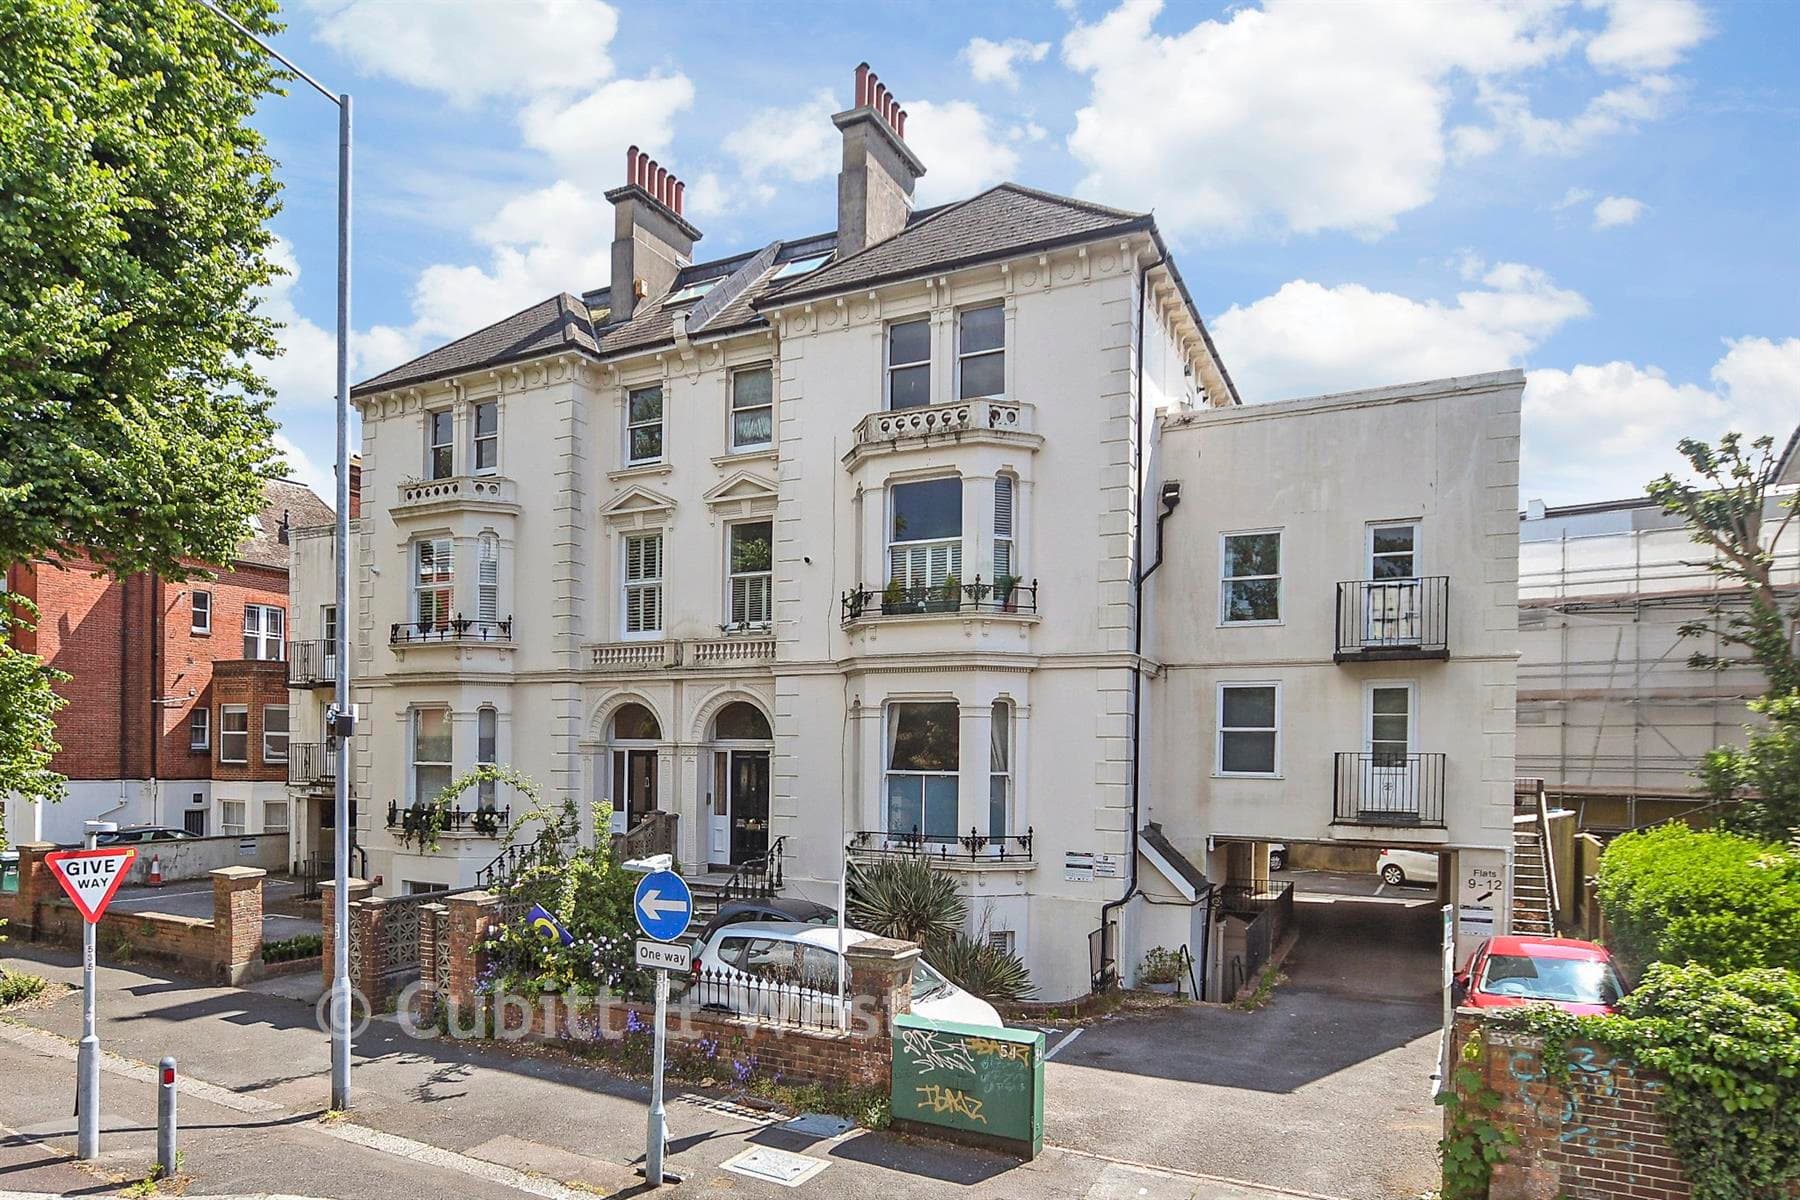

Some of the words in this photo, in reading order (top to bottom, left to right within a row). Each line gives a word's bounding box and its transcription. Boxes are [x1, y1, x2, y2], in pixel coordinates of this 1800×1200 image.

[66, 859, 116, 876] GIVE
[1473, 869, 1497, 878] Flats
[78, 877, 109, 889] WAY
[640, 946, 661, 960] One
[664, 952, 686, 966] way
[999, 1044, 1017, 1059] 54
